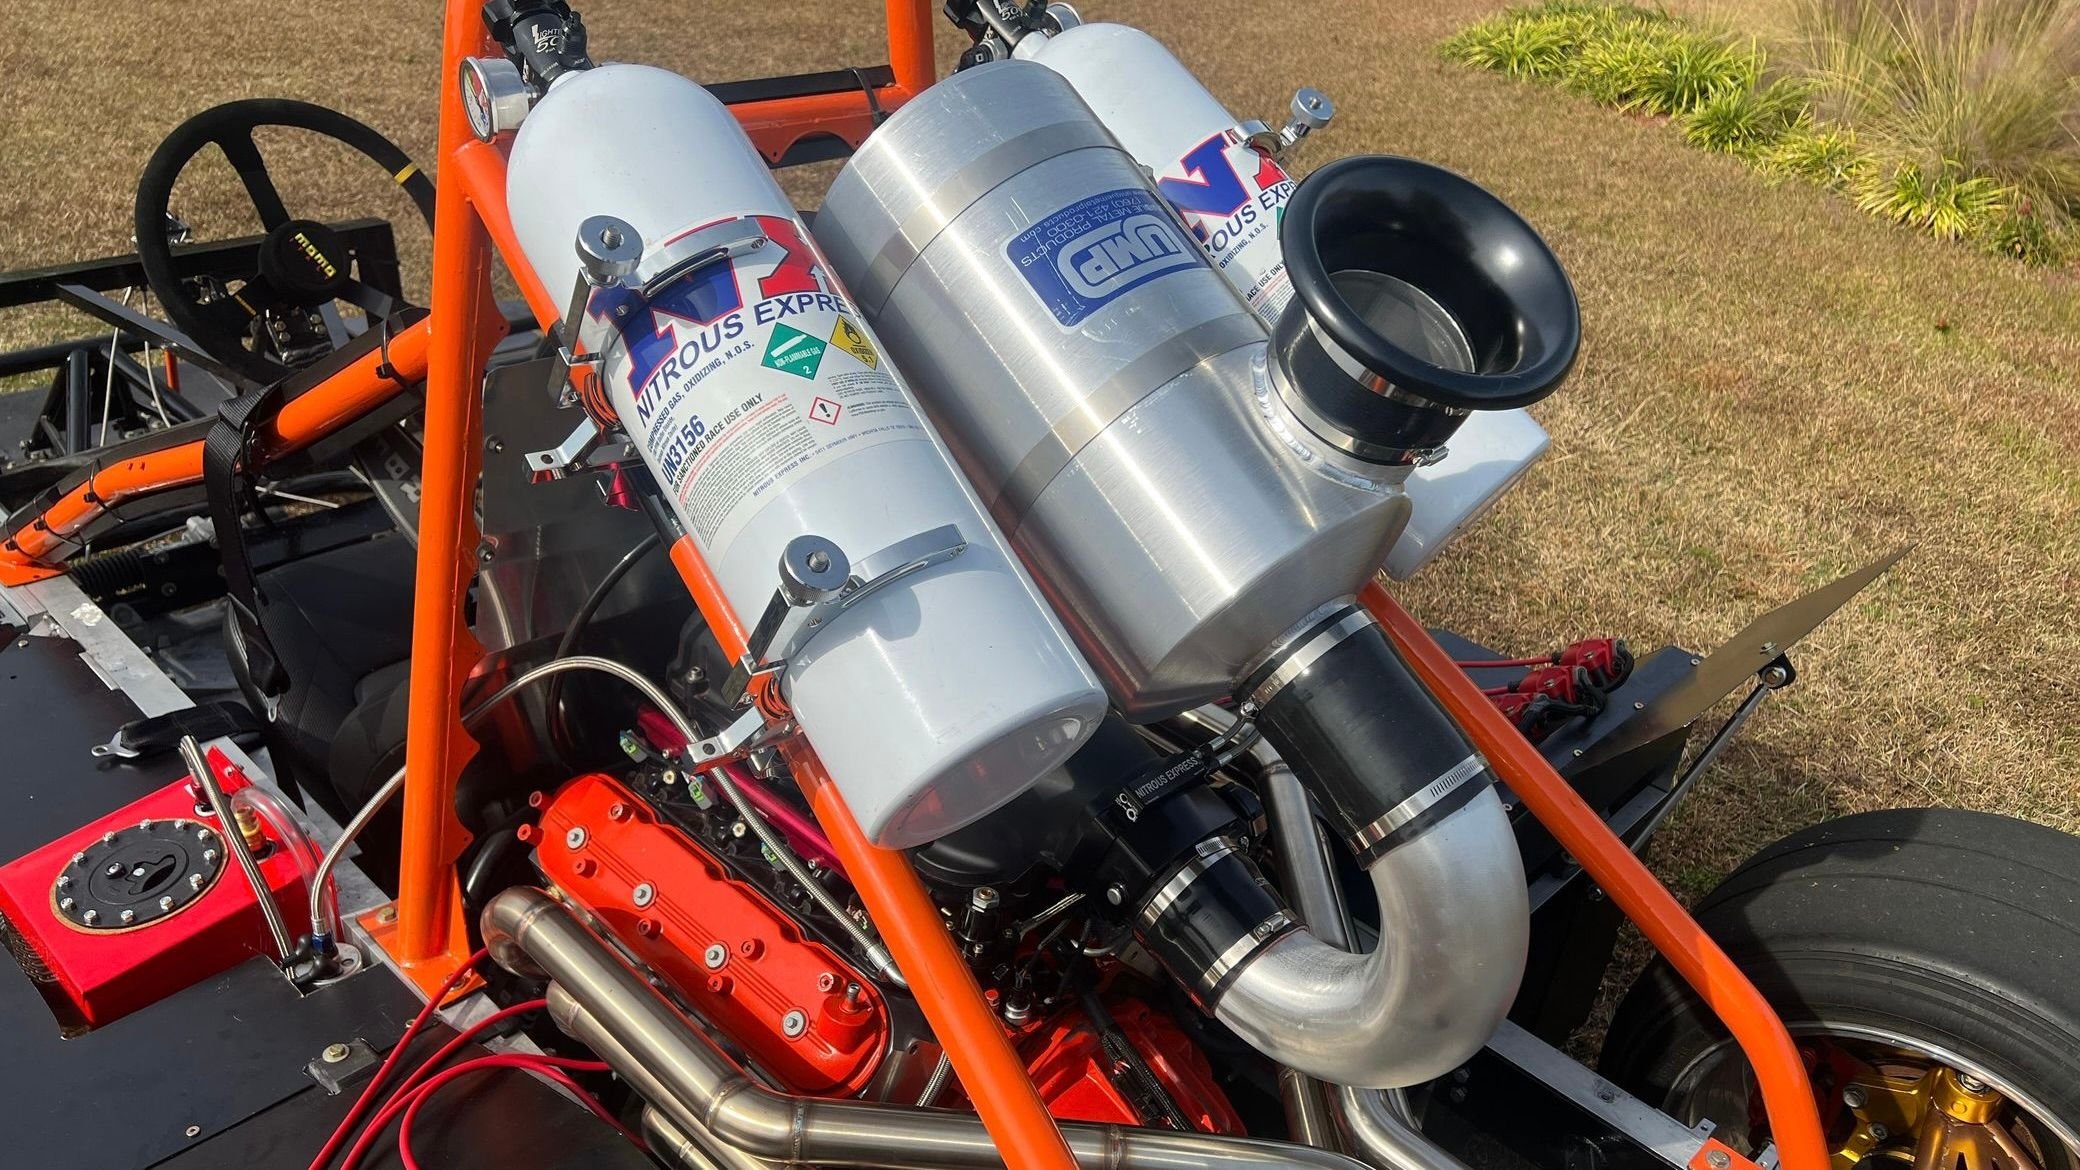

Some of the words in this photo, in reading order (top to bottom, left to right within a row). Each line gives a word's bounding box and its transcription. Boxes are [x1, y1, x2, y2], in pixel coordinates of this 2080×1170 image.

[1046, 204, 1109, 238] 421-0300
[1091, 205, 1132, 223] METAL
[1020, 220, 1092, 267] PRODUCTS
[1079, 223, 1182, 285] UMP
[1246, 285, 1261, 302] ACE
[1258, 275, 1272, 287] USE
[1271, 261, 1285, 276] ONL
[636, 312, 744, 429] NITROUS
[753, 293, 854, 326] EXPRE
[803, 365, 812, 375] 2
[647, 406, 670, 453] COMPRESSED
[667, 391, 686, 410] GAS,
[683, 357, 726, 392] OXIDIZING,
[726, 341, 755, 360] N.O.S.
[661, 414, 706, 486] UN3156
[677, 439, 706, 485] SANCTIONED
[705, 422, 726, 446] RACE
[724, 408, 743, 427] USE
[741, 392, 765, 415] ONLY
[753, 476, 774, 497] NITROUS
[775, 460, 798, 481] EXPRESS
[1135, 774, 1168, 799] NITROUS
[1167, 756, 1199, 781] EXPRESS
